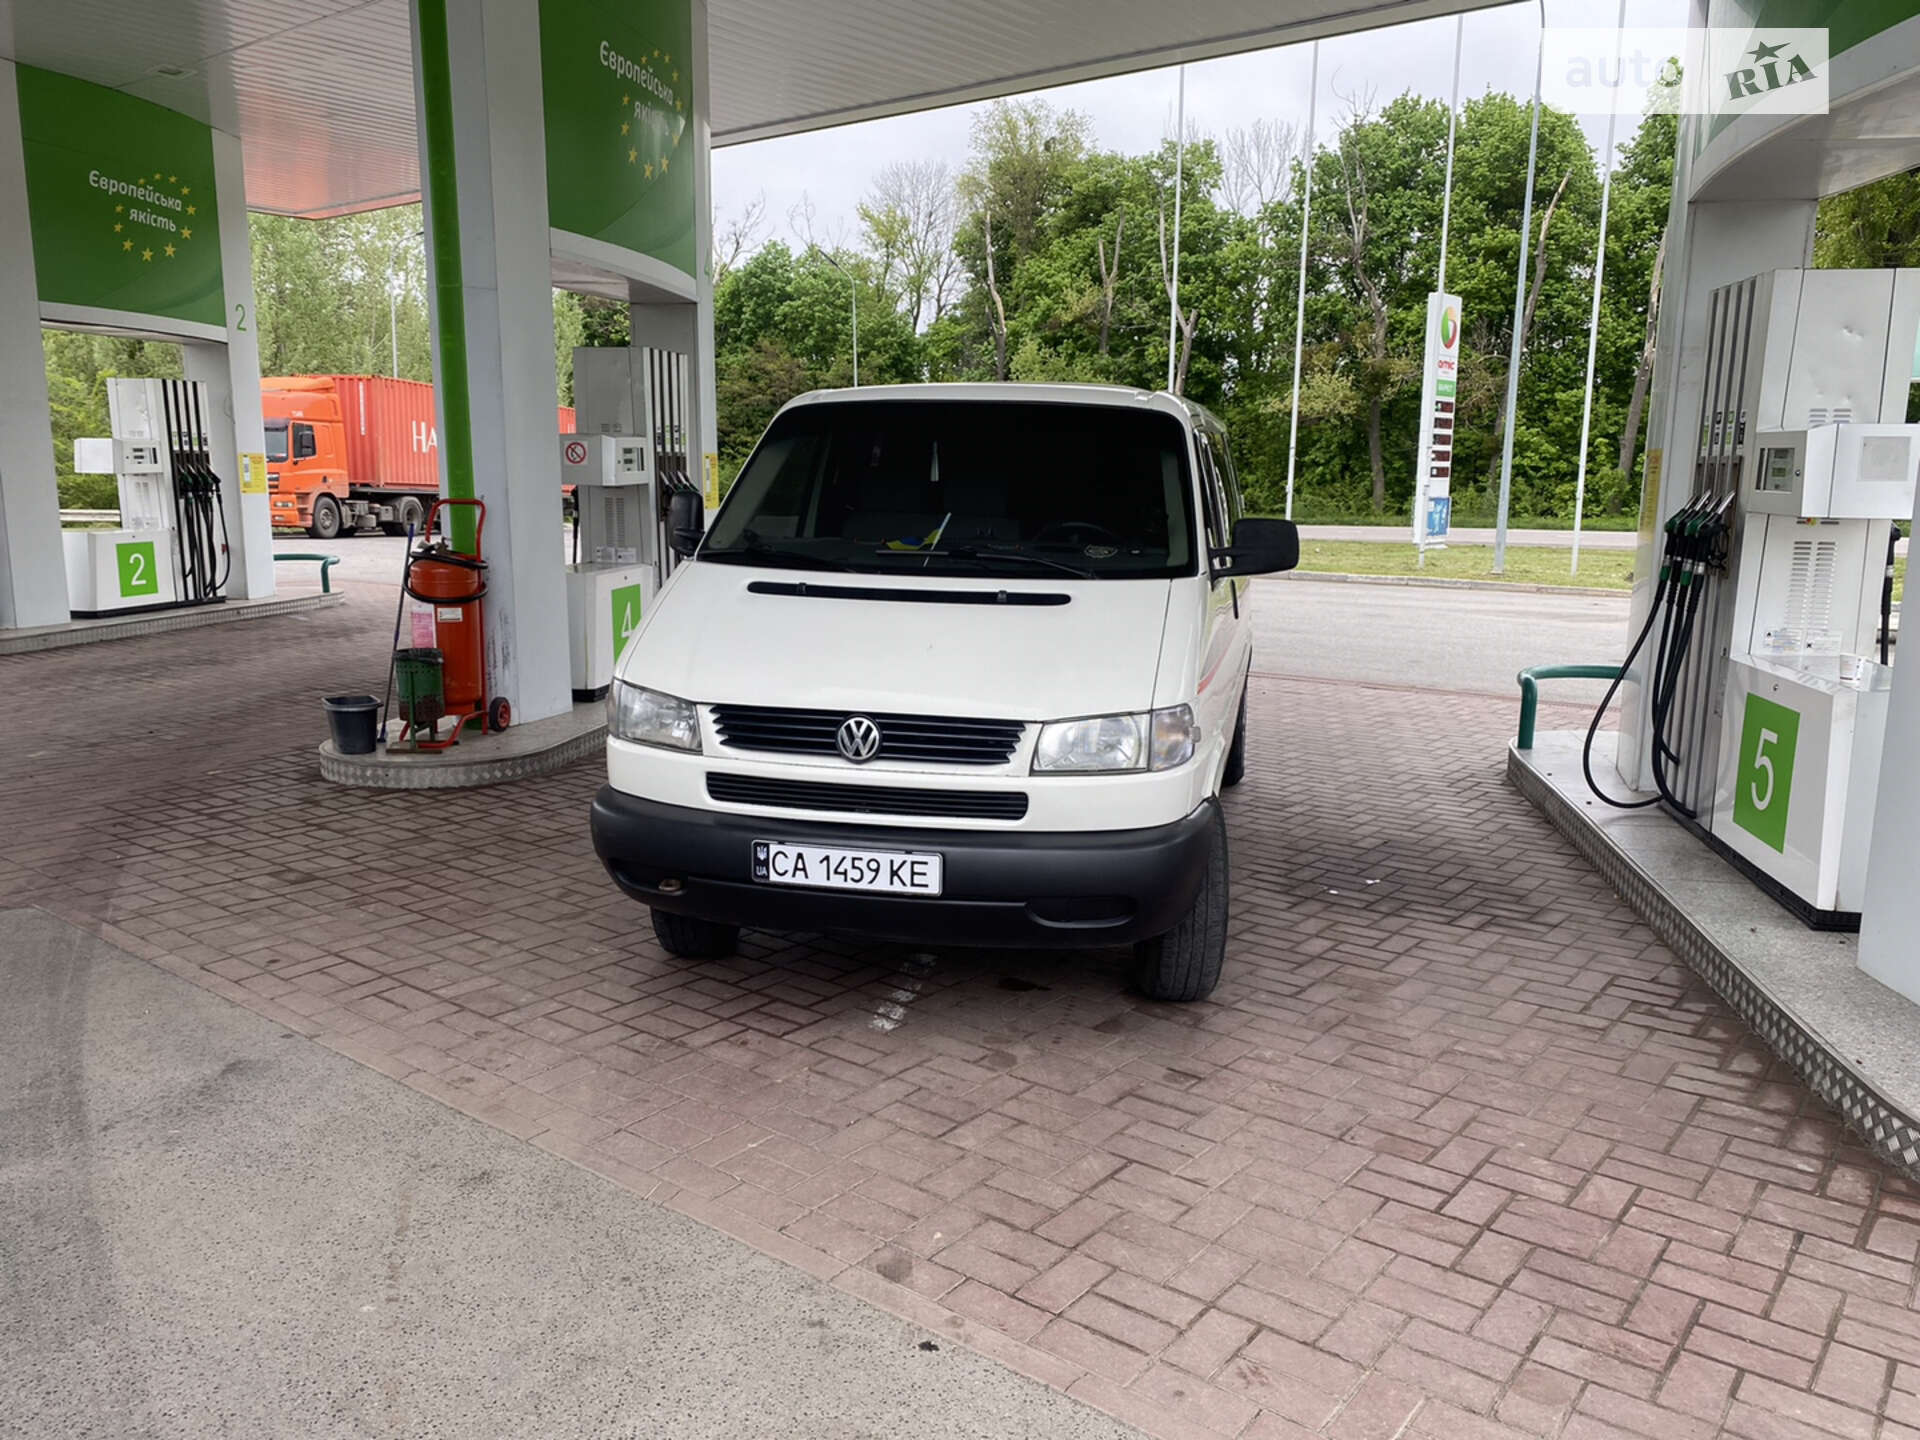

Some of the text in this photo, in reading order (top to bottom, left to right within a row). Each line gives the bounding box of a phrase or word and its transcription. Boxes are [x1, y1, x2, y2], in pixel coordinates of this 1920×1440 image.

[600, 40, 673, 105] Європейська
[88, 170, 182, 211] Європейська
[129, 208, 176, 232] якість
[235, 303, 247, 331] 2
[129, 553, 147, 586] 2
[621, 600, 635, 638] 4
[1751, 727, 1779, 811] 5
[756, 865, 768, 876] UA
[772, 850, 929, 888] CA 1459 KE
